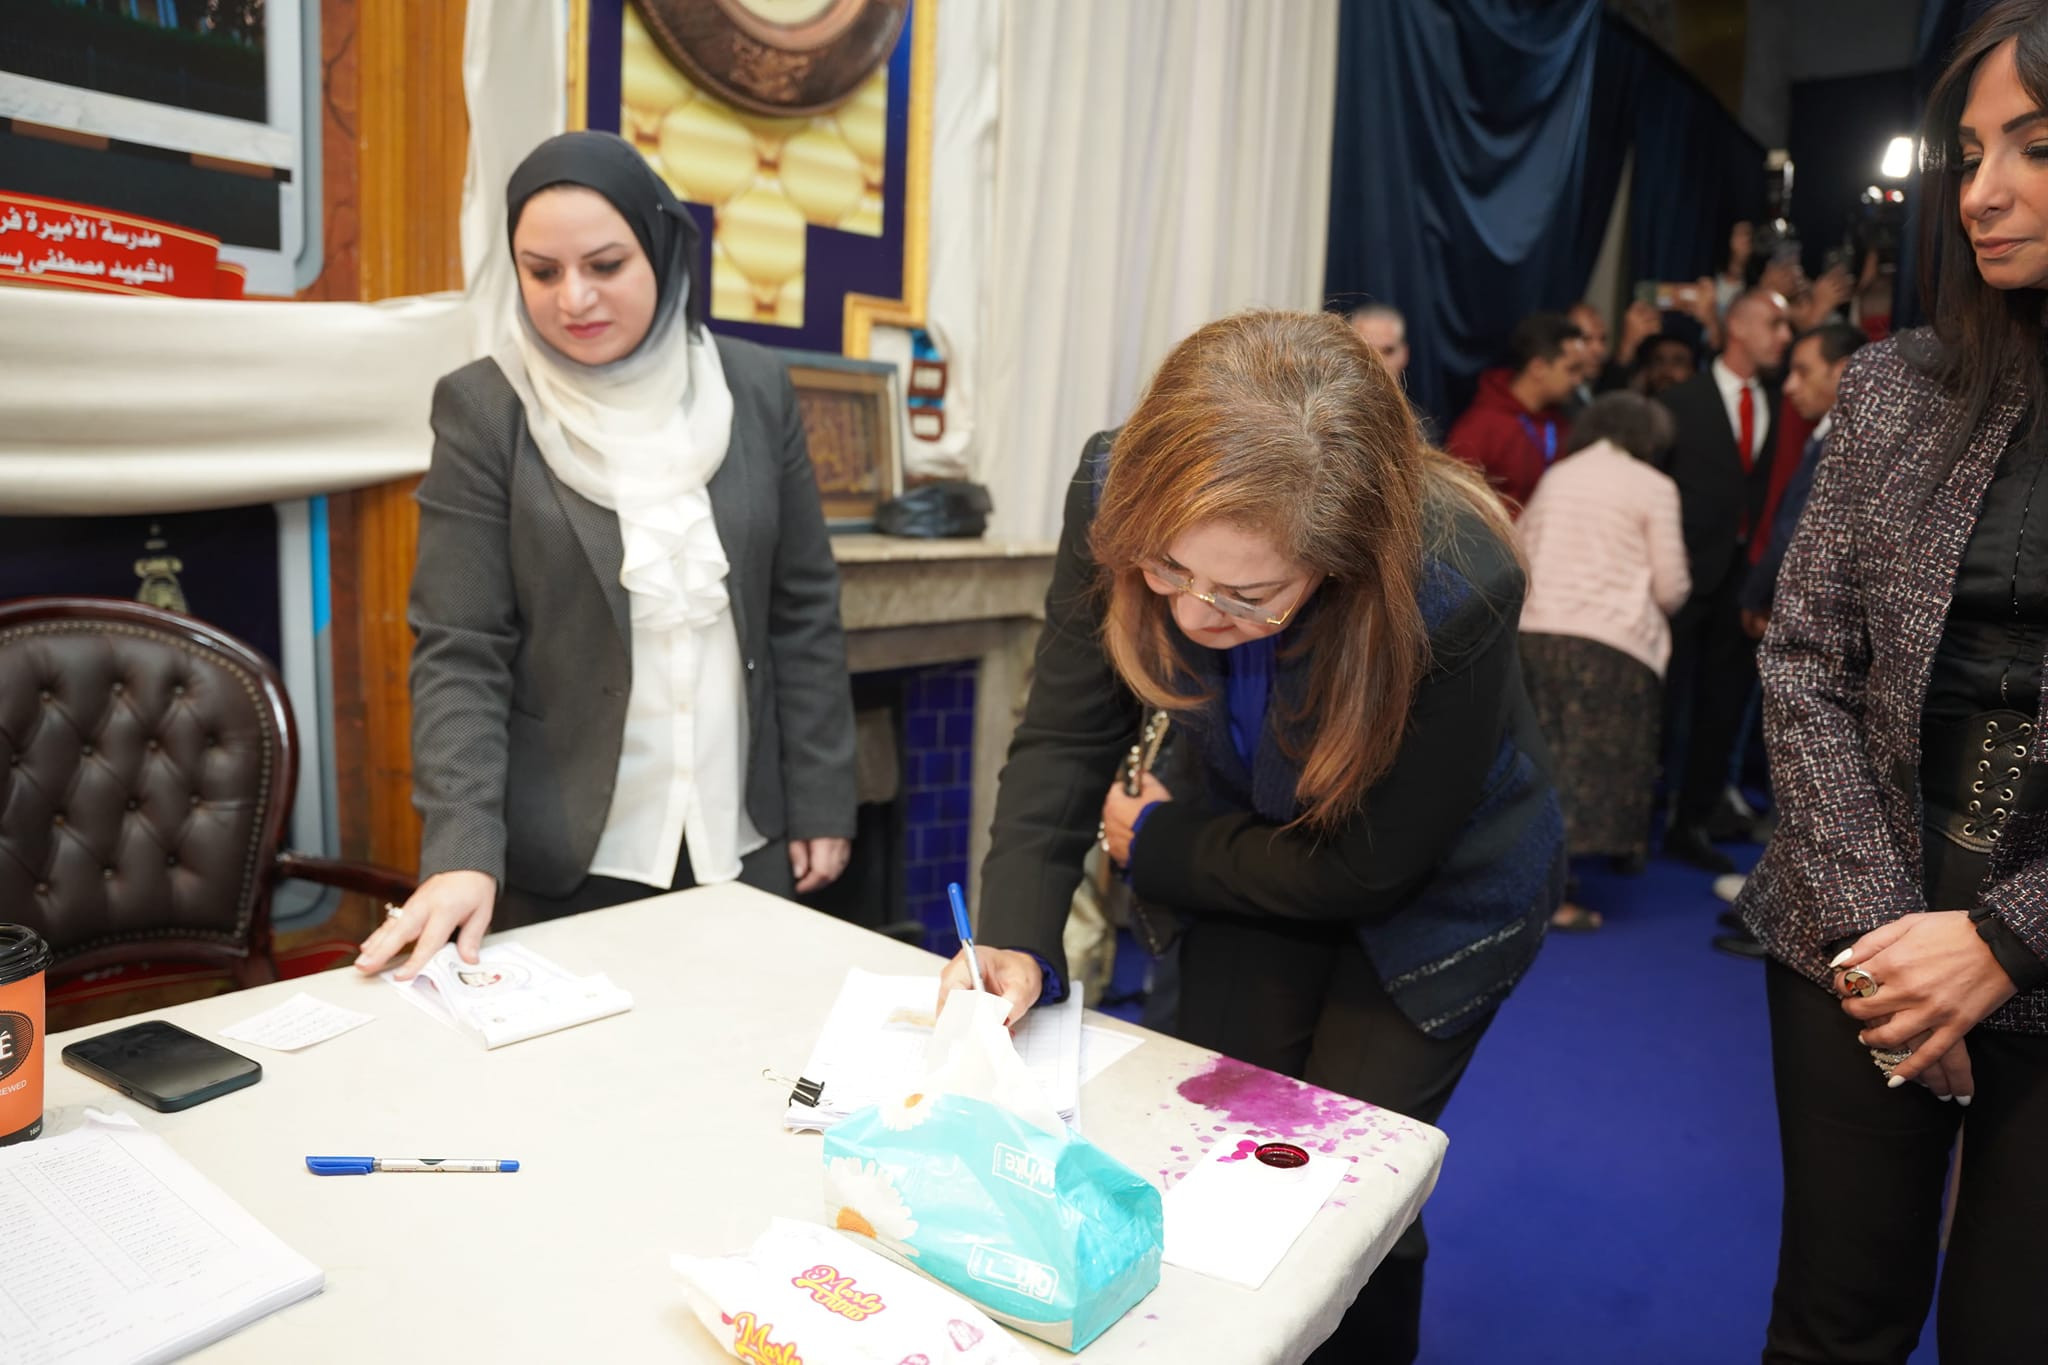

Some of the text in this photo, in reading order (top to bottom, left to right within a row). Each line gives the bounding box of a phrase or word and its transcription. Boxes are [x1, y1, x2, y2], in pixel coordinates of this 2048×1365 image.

[99, 220, 162, 250] مدرسة
[109, 258, 174, 285] الشهيد
[0, 1080, 27, 1097] EWED
